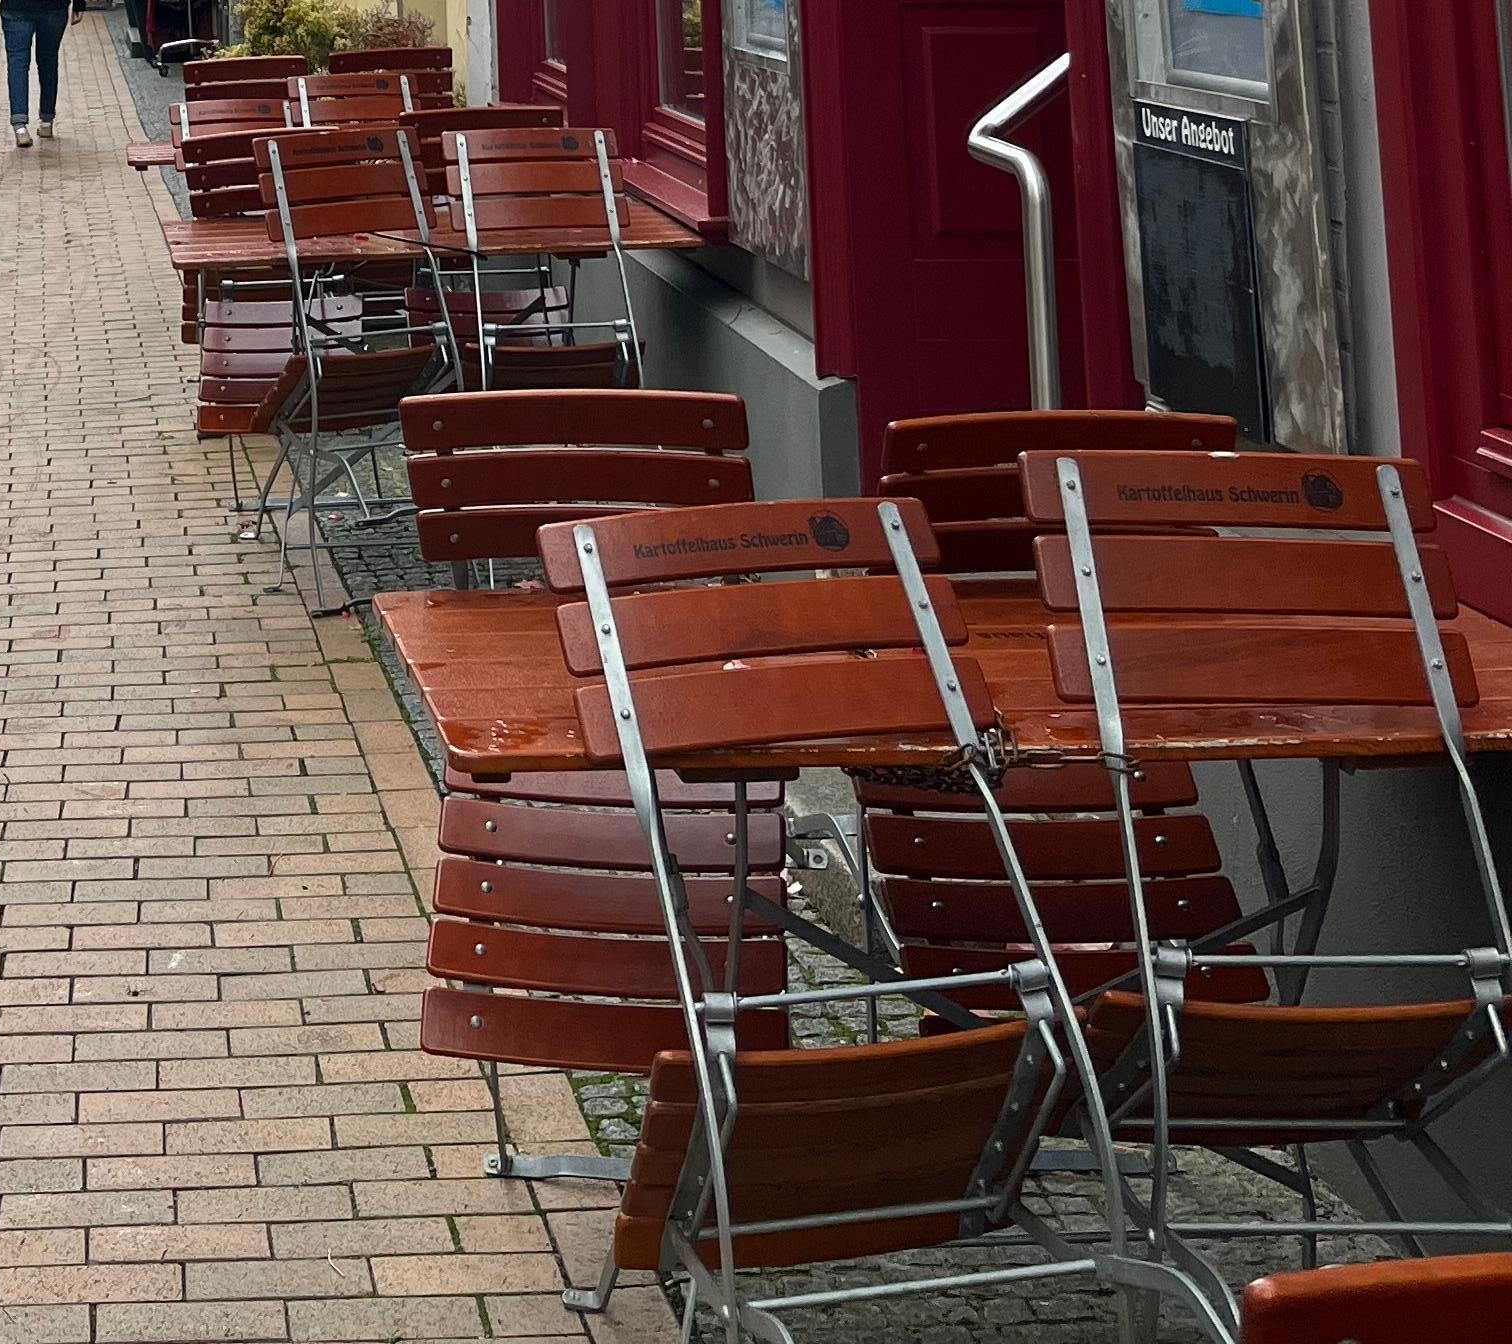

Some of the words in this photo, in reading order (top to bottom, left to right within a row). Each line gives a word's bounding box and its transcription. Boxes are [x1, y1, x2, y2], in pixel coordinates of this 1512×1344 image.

[1141, 107, 1178, 142] Unser
[1181, 115, 1235, 155] Angebot
[1117, 484, 1224, 502] Kartoffelhaus
[1229, 486, 1300, 504] Schwerin
[633, 536, 737, 560] Kartoffelhaus
[739, 528, 809, 550] Schwerin
